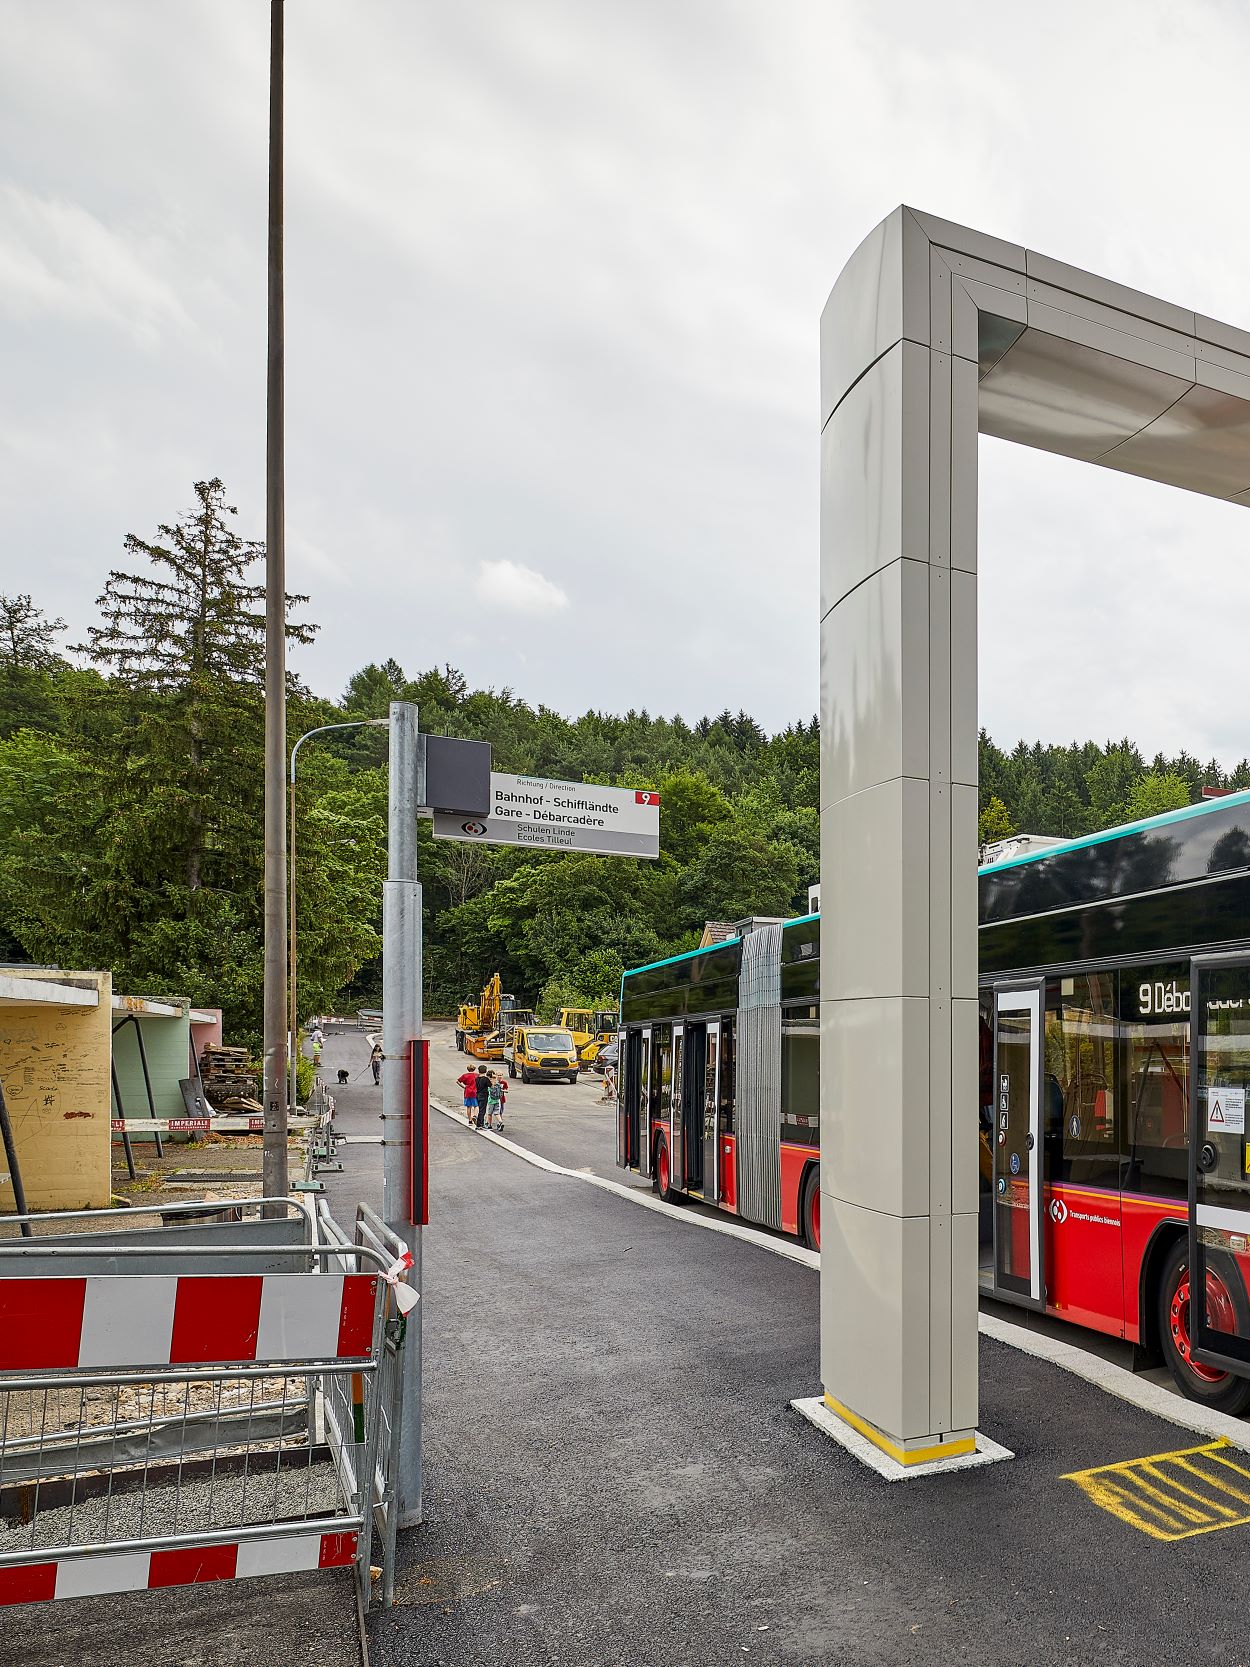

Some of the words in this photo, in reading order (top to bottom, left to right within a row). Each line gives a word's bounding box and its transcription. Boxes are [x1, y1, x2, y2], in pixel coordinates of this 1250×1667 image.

[517, 779, 544, 789] Richtung
[549, 782, 576, 792] Direction
[495, 790, 543, 806] Bahnhof
[553, 797, 619, 814] Schiffländte
[641, 793, 650, 805] 9
[495, 805, 523, 818] Gare
[533, 809, 605, 827] Débarcadère
[517, 824, 551, 835] Schulen
[552, 827, 576, 837] Linde
[517, 833, 545, 843] Ecoles
[547, 835, 573, 846] Tilleul
[1139, 983, 1152, 1014] 9
[1069, 1209, 1090, 1221] Transports
[1089, 1214, 1104, 1223] publics
[1103, 1216, 1121, 1227] biennois
